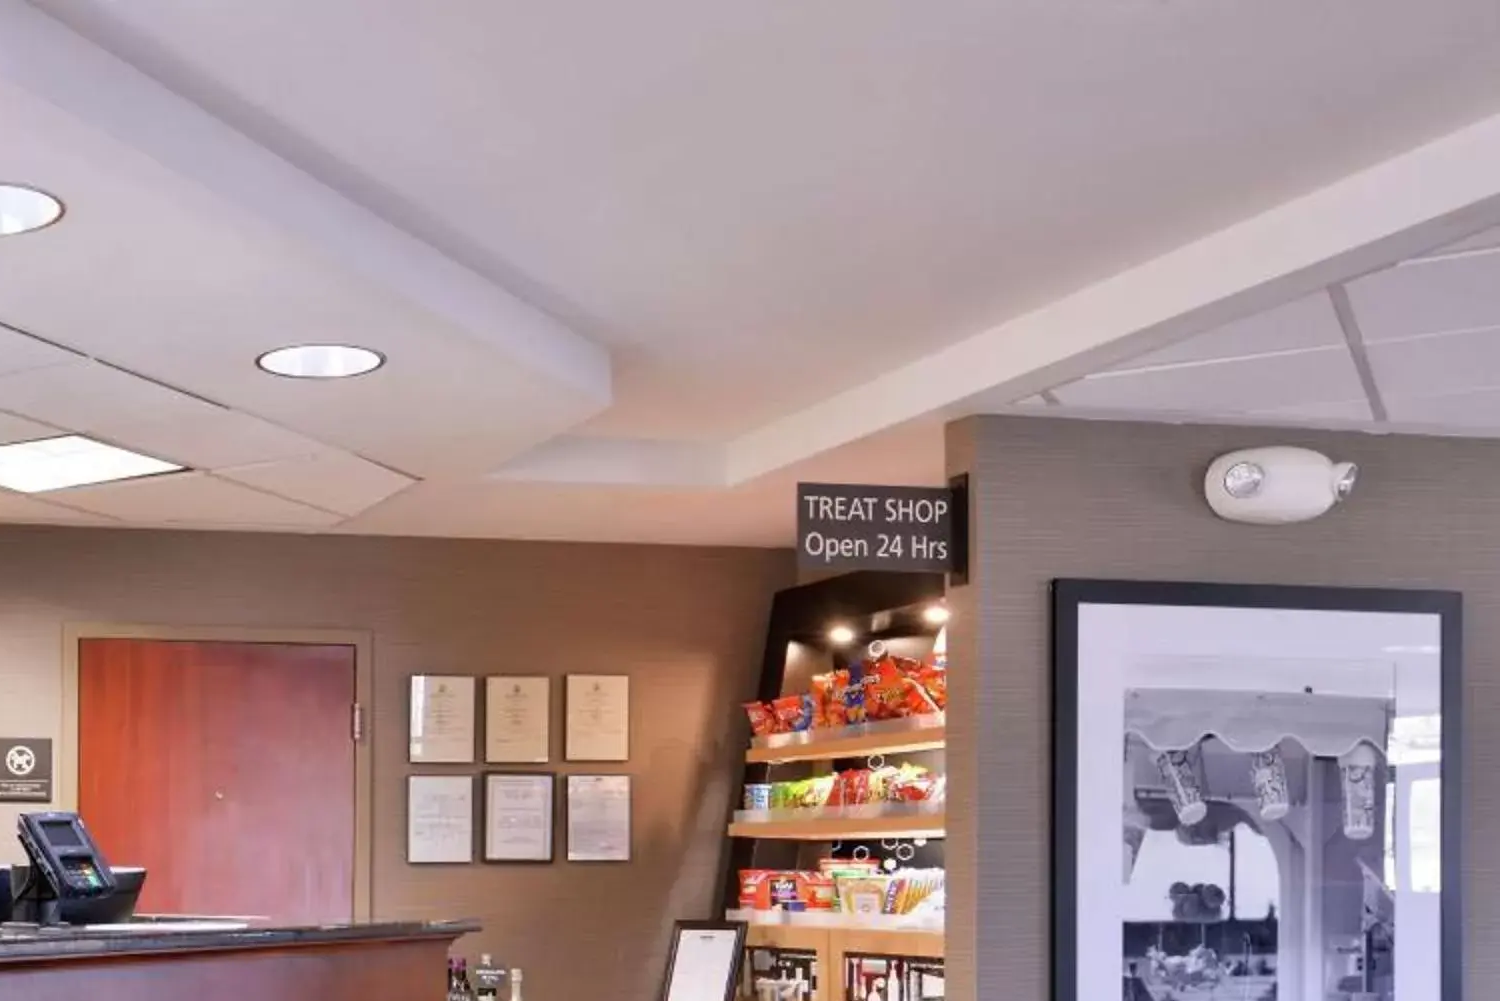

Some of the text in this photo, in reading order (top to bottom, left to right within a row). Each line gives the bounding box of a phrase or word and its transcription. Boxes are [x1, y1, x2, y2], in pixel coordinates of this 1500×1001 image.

[804, 495, 948, 524] TREAT SHOP
[805, 532, 948, 563] Open 24 Hrs
